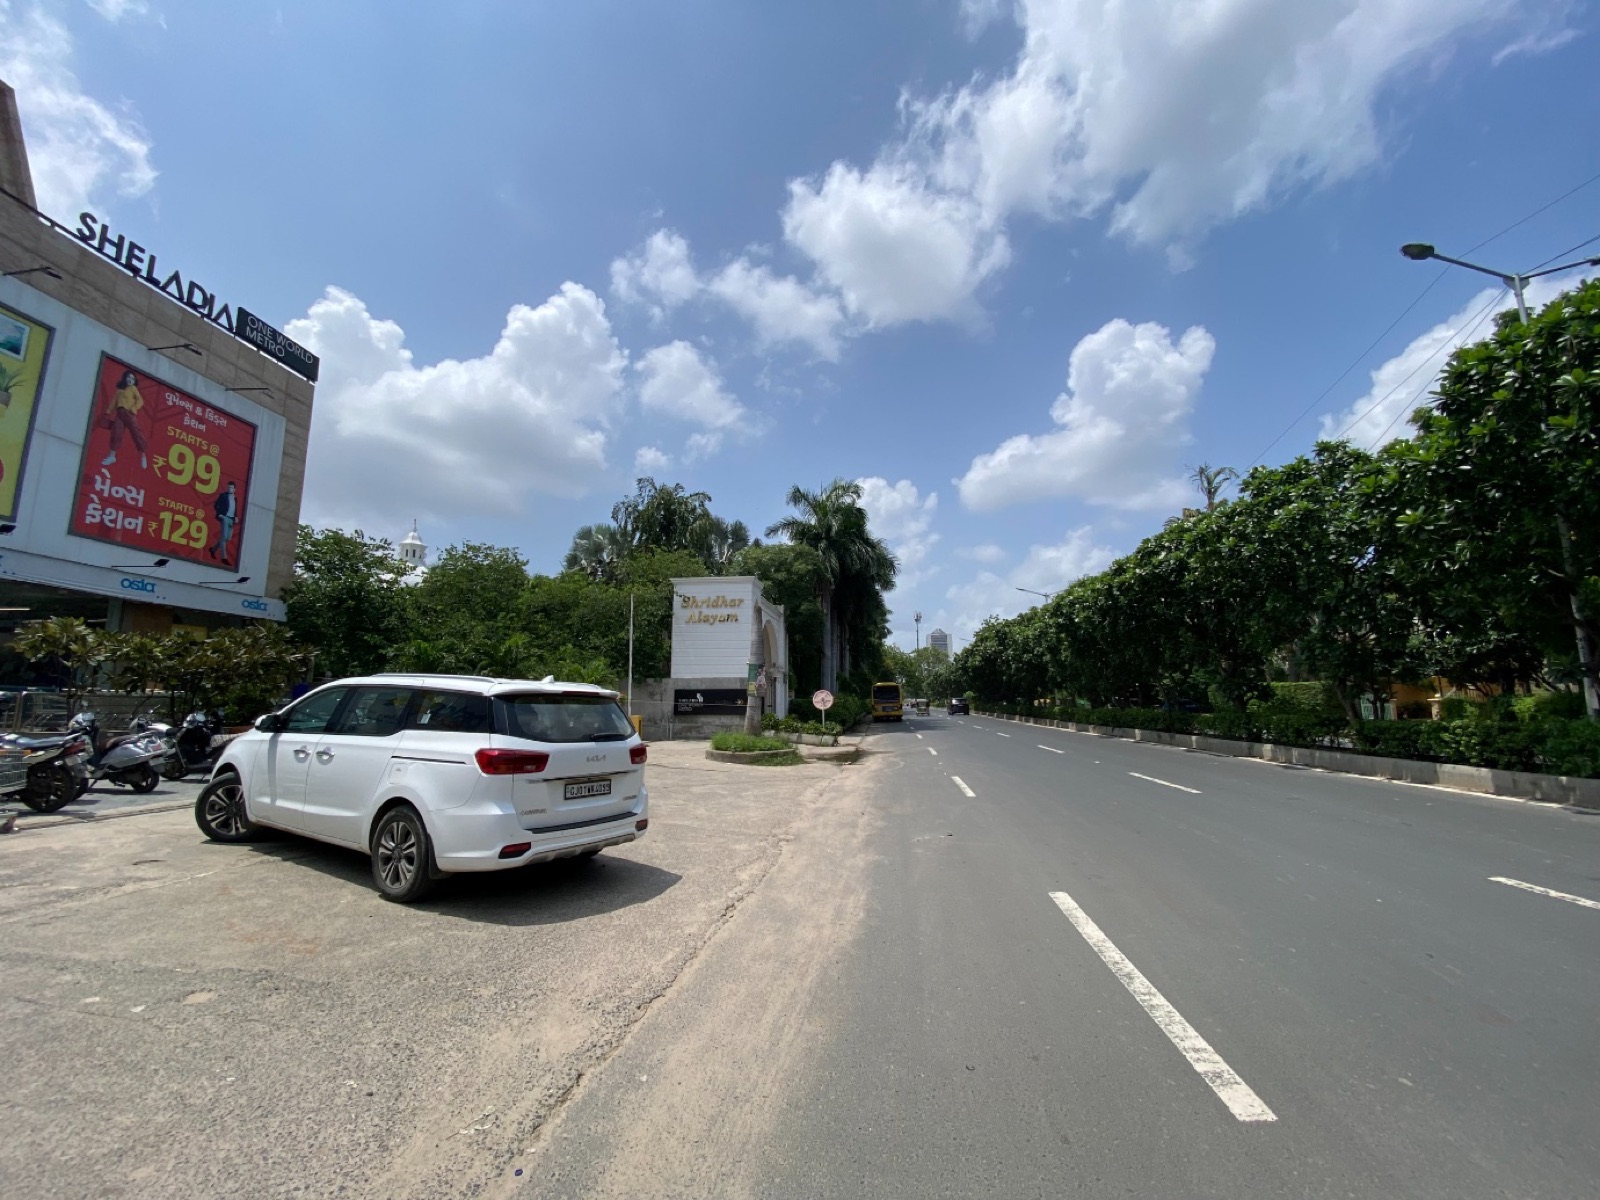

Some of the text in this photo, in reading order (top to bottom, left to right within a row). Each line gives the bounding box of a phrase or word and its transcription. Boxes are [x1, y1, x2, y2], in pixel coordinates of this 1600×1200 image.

[76, 211, 235, 331] SHELADIA
[246, 326, 285, 357] METRO
[247, 315, 314, 364] ONE WORLD
[167, 425, 220, 457] STARTS @
[94, 468, 145, 508] મેન્સ
[85, 493, 144, 535] ફેશન
[158, 496, 206, 519] STARTS @
[120, 577, 156, 593] osia
[241, 597, 268, 612] osia
[681, 595, 745, 609] Shridhar
[684, 610, 739, 626] Alayam
